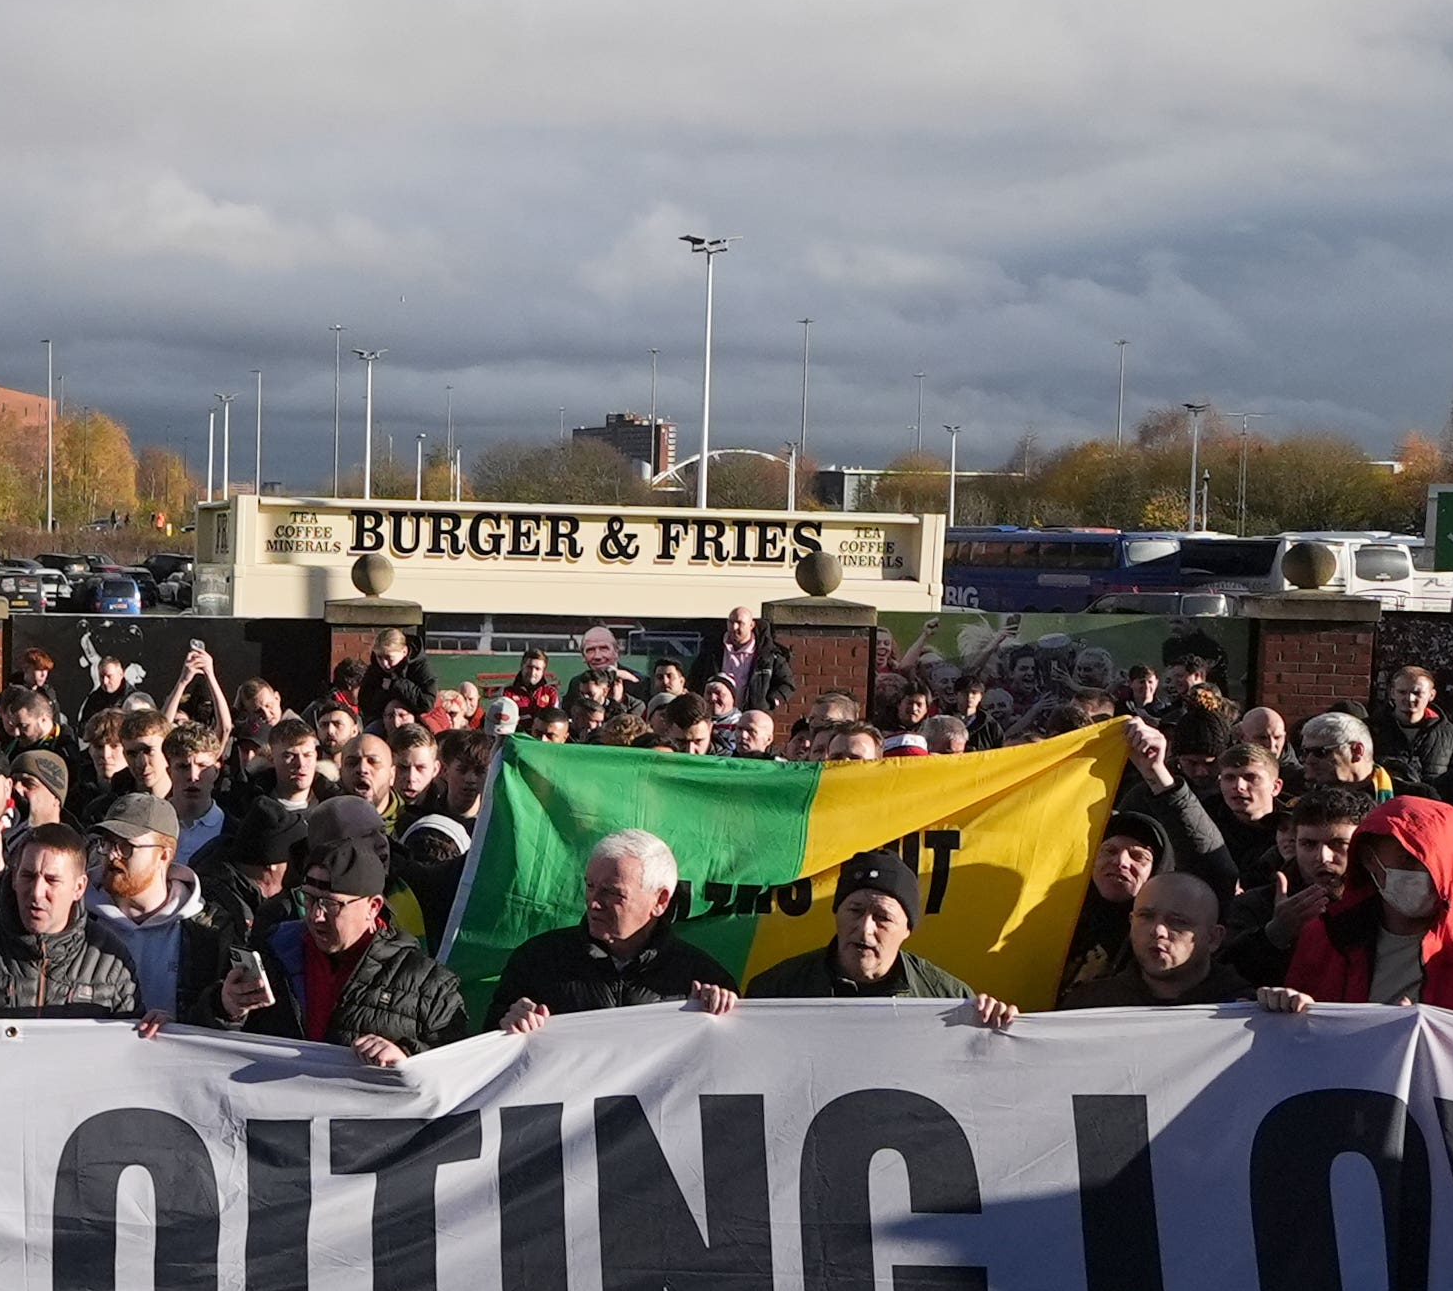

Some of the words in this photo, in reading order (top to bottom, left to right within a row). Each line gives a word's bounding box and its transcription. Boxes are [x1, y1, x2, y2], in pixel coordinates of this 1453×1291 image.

[289, 511, 319, 524] TEA
[273, 524, 333, 539] COFFEE
[348, 508, 584, 561] BURGER
[597, 514, 641, 563] &
[655, 516, 824, 567] FRIES
[854, 526, 882, 539] TEA
[264, 538, 342, 554] MINERALS
[838, 539, 896, 554] COFFEE
